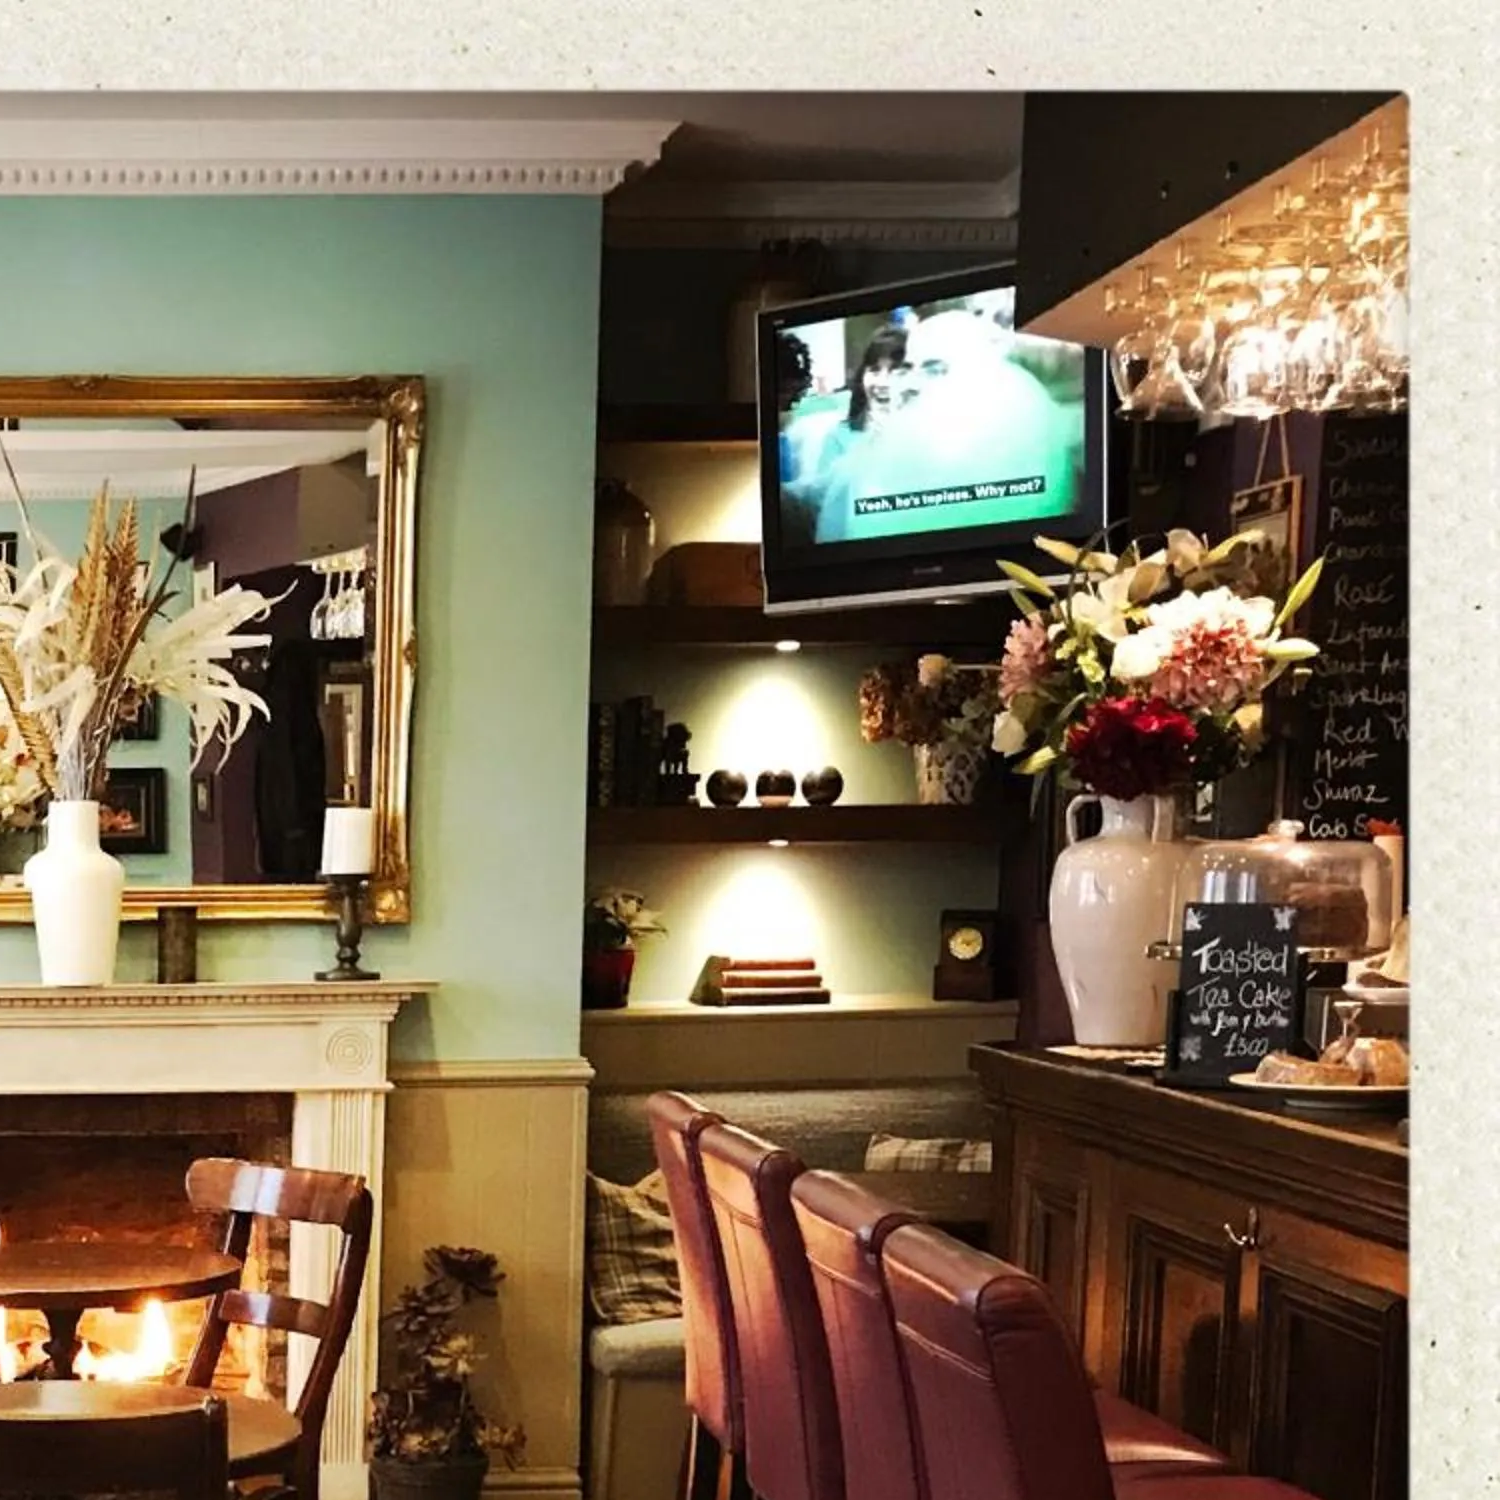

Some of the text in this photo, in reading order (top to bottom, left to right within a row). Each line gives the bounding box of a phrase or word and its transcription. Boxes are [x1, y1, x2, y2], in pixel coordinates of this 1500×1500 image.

[857, 478, 1042, 513] Yeah, he's topless. Why not?
[1333, 573, 1396, 611] Rosé
[1323, 716, 1378, 746] Red
[1314, 749, 1379, 779] Merlot
[1303, 778, 1390, 811] Shiraz
[1309, 813, 1348, 839] Cab
[1191, 937, 1289, 978] Toasted
[1186, 976, 1292, 1010] Tea Cake
